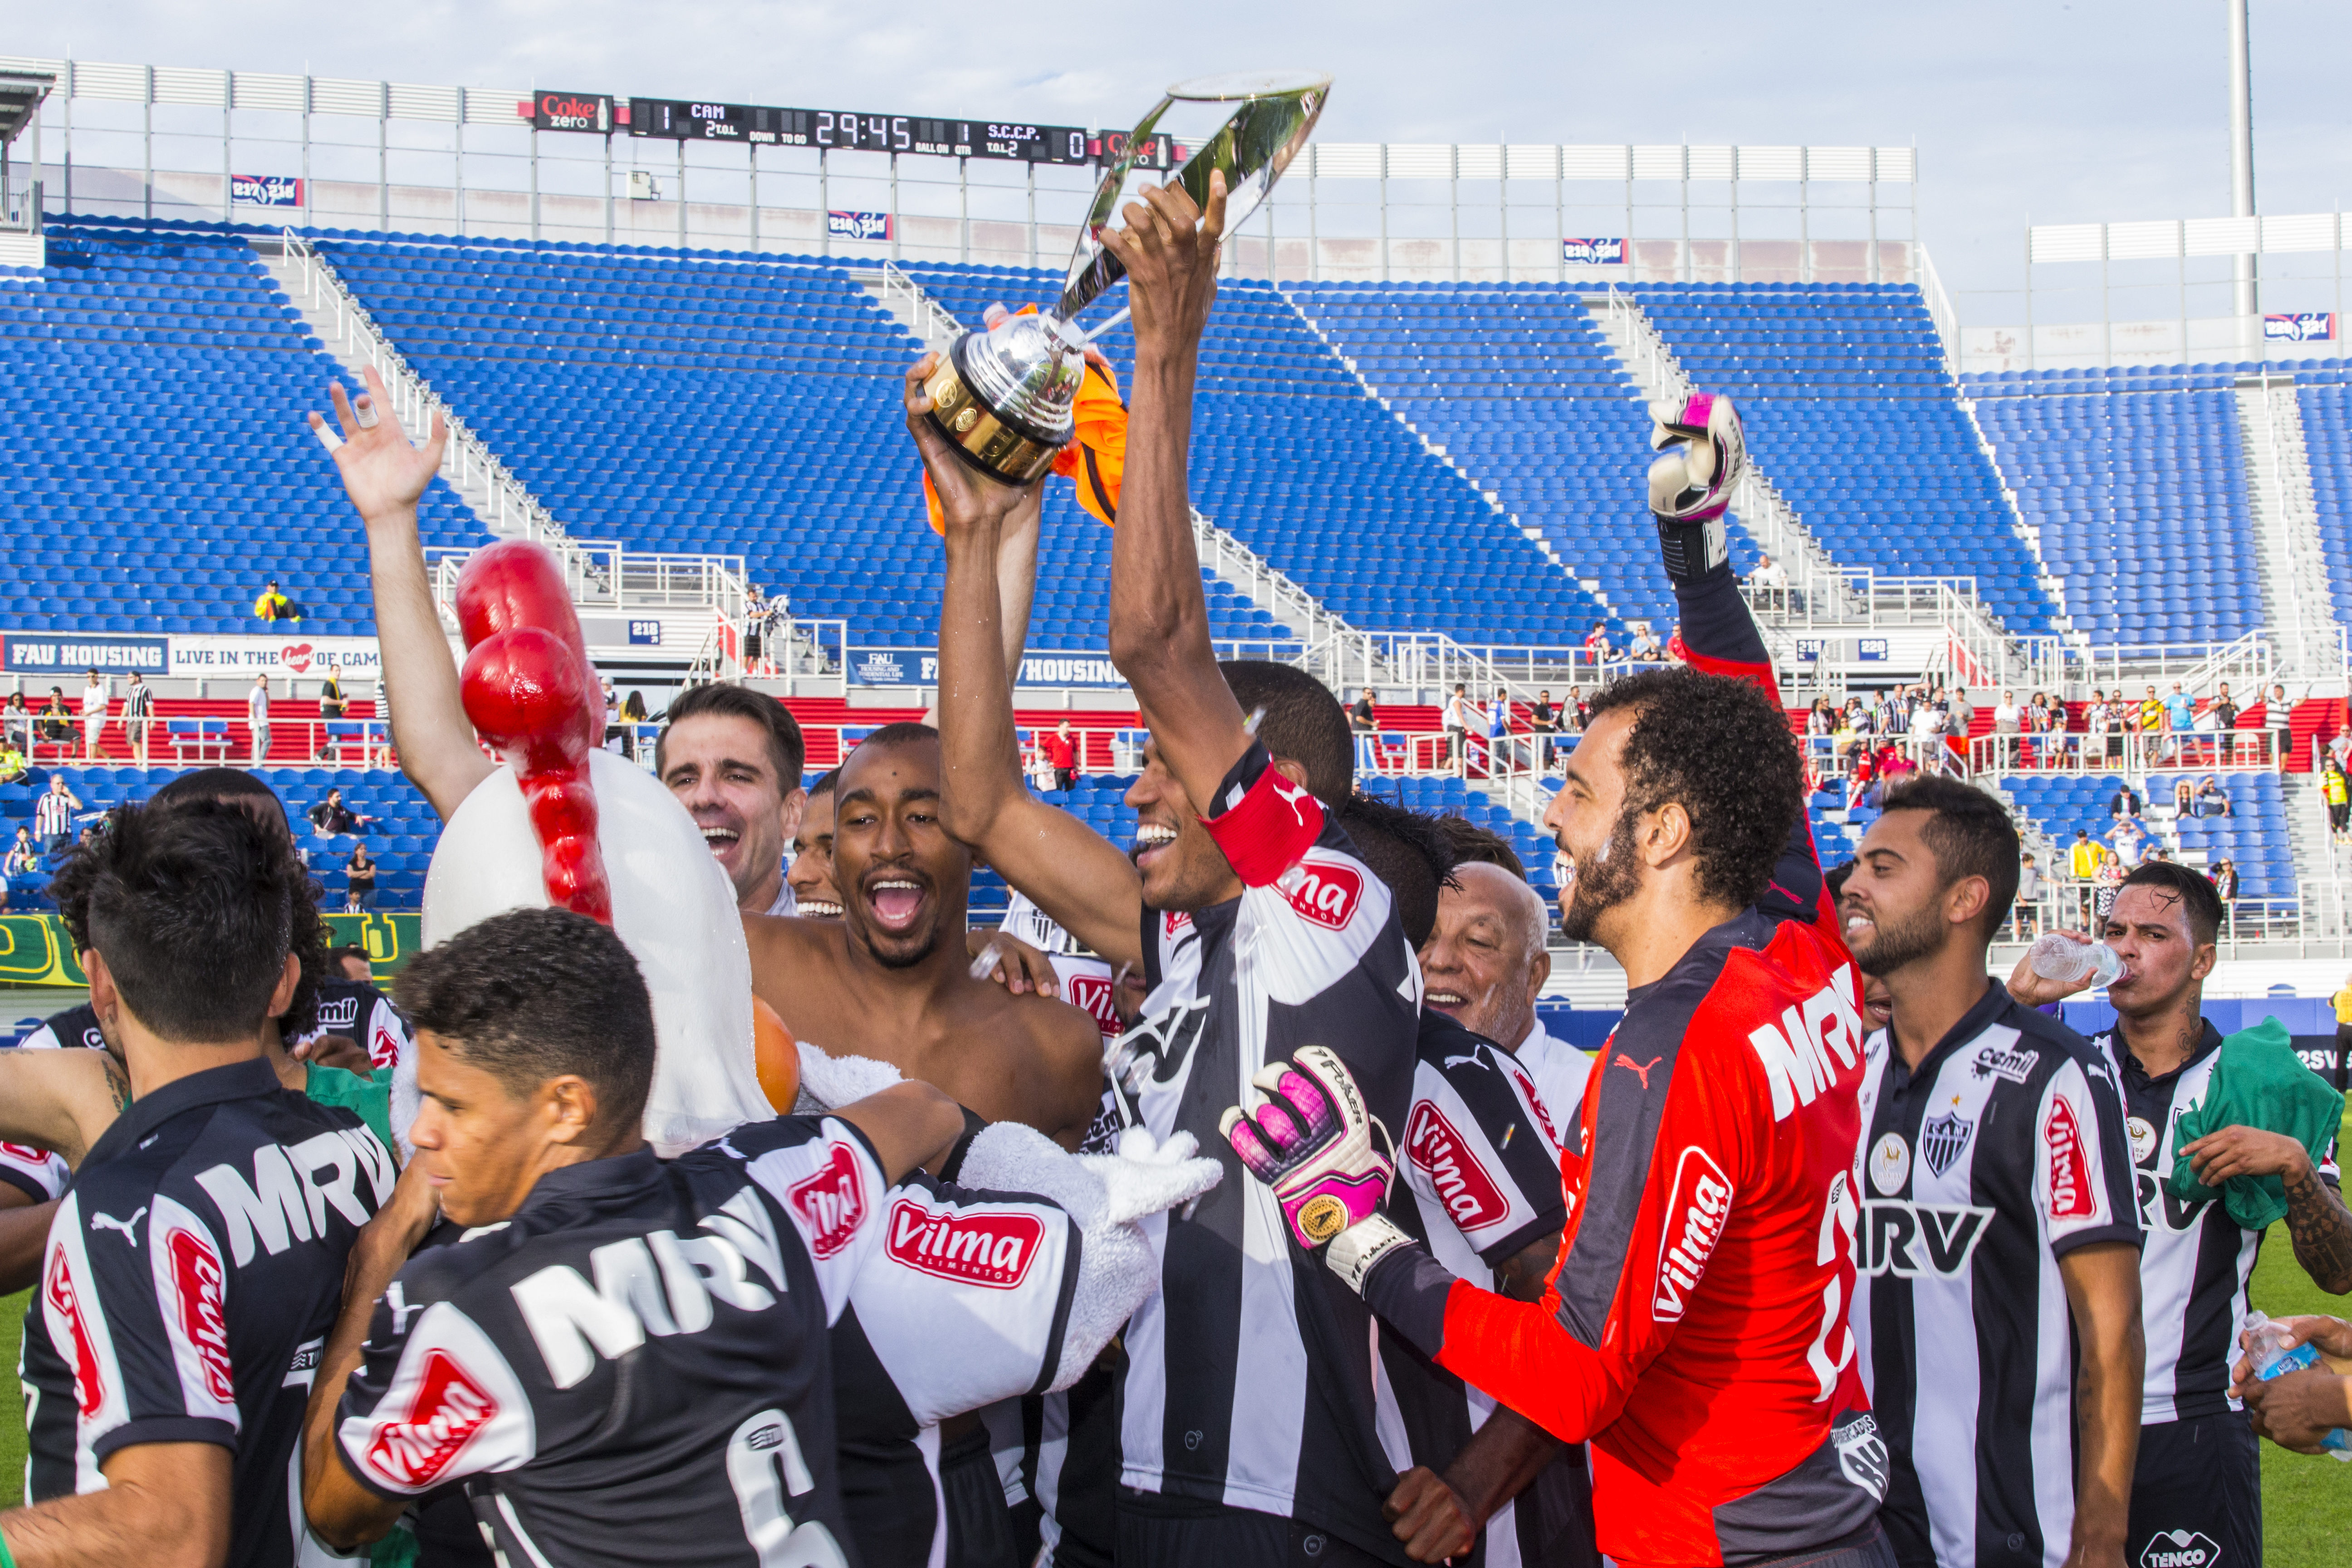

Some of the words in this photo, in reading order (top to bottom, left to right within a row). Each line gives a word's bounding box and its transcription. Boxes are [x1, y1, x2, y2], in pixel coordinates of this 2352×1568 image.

[542, 95, 595, 118] Coke
[691, 104, 725, 119] CAM
[550, 116, 588, 128] zero
[706, 121, 715, 137] 2
[817, 112, 910, 149] 29:45
[750, 131, 775, 142] DOWN
[781, 133, 794, 144] TO
[794, 134, 807, 145] GO
[988, 124, 1040, 140] S.C.C.P.
[915, 142, 936, 153] BALL
[936, 143, 949, 154] ON
[955, 144, 972, 156] QTR
[1007, 140, 1018, 157] 2
[1069, 132, 1085, 158] 0
[1107, 134, 1156, 156] Ce
[232, 182, 261, 197] 217
[267, 184, 295, 199] 218
[829, 217, 854, 231] 218
[861, 219, 885, 233] 219
[1564, 245, 1590, 257] 219
[1595, 245, 1621, 258] 220
[2265, 321, 2293, 334] 220
[2301, 319, 2328, 333] 221
[632, 622, 659, 636] 218
[12, 643, 56, 665] FAU
[60, 644, 163, 667] HOUSING
[1861, 640, 1886, 653] 220
[175, 650, 214, 664] LIVE
[220, 651, 239, 665] IN
[244, 651, 279, 665] THE
[284, 647, 315, 667] heart
[316, 652, 337, 666] OF
[343, 652, 380, 666] CAM
[868, 653, 894, 665] FAU
[1289, 896, 1337, 926] ENTOS
[318, 997, 358, 1022] mil
[1748, 961, 1863, 1123] MRV
[194, 1122, 396, 1269] MRV
[895, 1210, 1024, 1273] Vilma
[1655, 1174, 1726, 1313] Vilma
[1857, 1198, 1996, 1279] RV
[916, 1254, 1014, 1283] ALIMENTOS
[510, 1184, 789, 1391] MRV
[2148, 1549, 2206, 1568] TENCO
